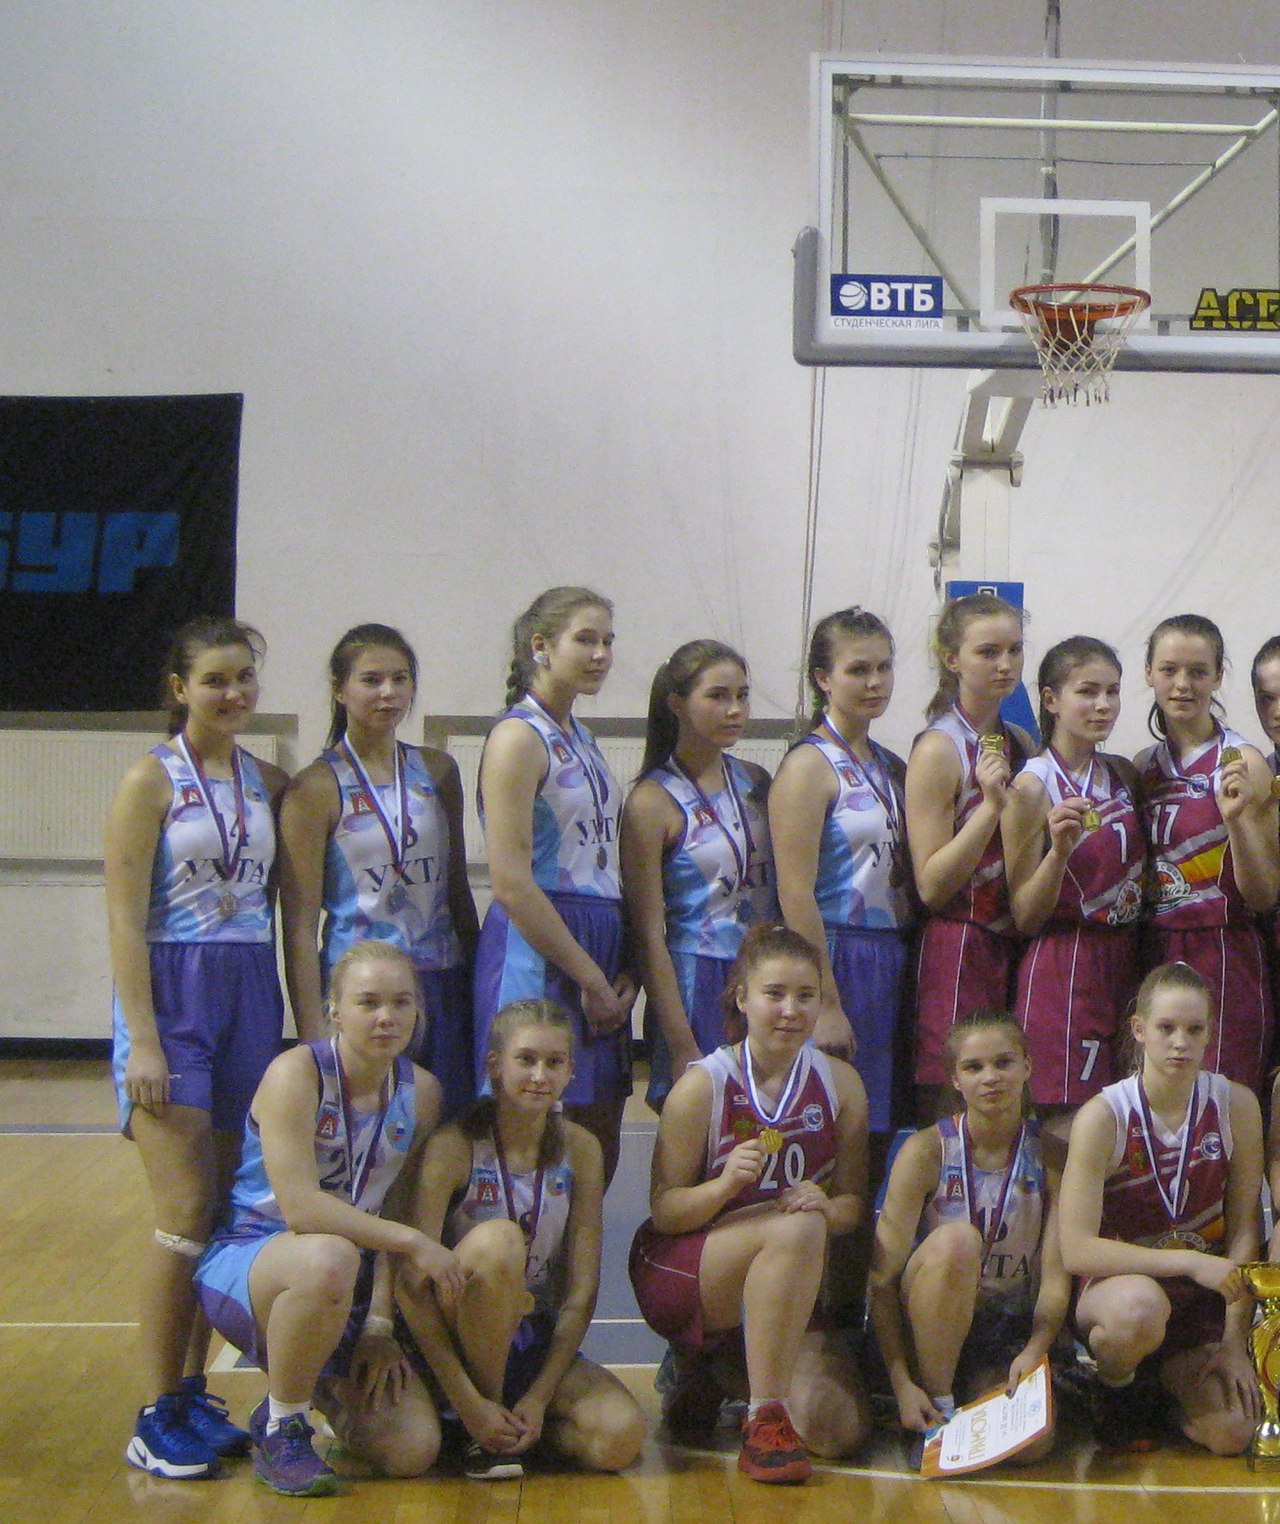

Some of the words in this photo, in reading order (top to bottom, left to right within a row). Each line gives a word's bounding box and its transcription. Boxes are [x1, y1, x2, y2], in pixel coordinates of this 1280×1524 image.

[870, 282, 935, 312] ВТБ
[833, 318, 912, 328] СТУДЕНЧЕСКАЯ
[914, 320, 940, 329] ЛИГА
[0, 511, 181, 592] УР
[1151, 803, 1180, 845] 17
[1080, 1039, 1100, 1081] 7
[759, 1142, 806, 1190] 20
